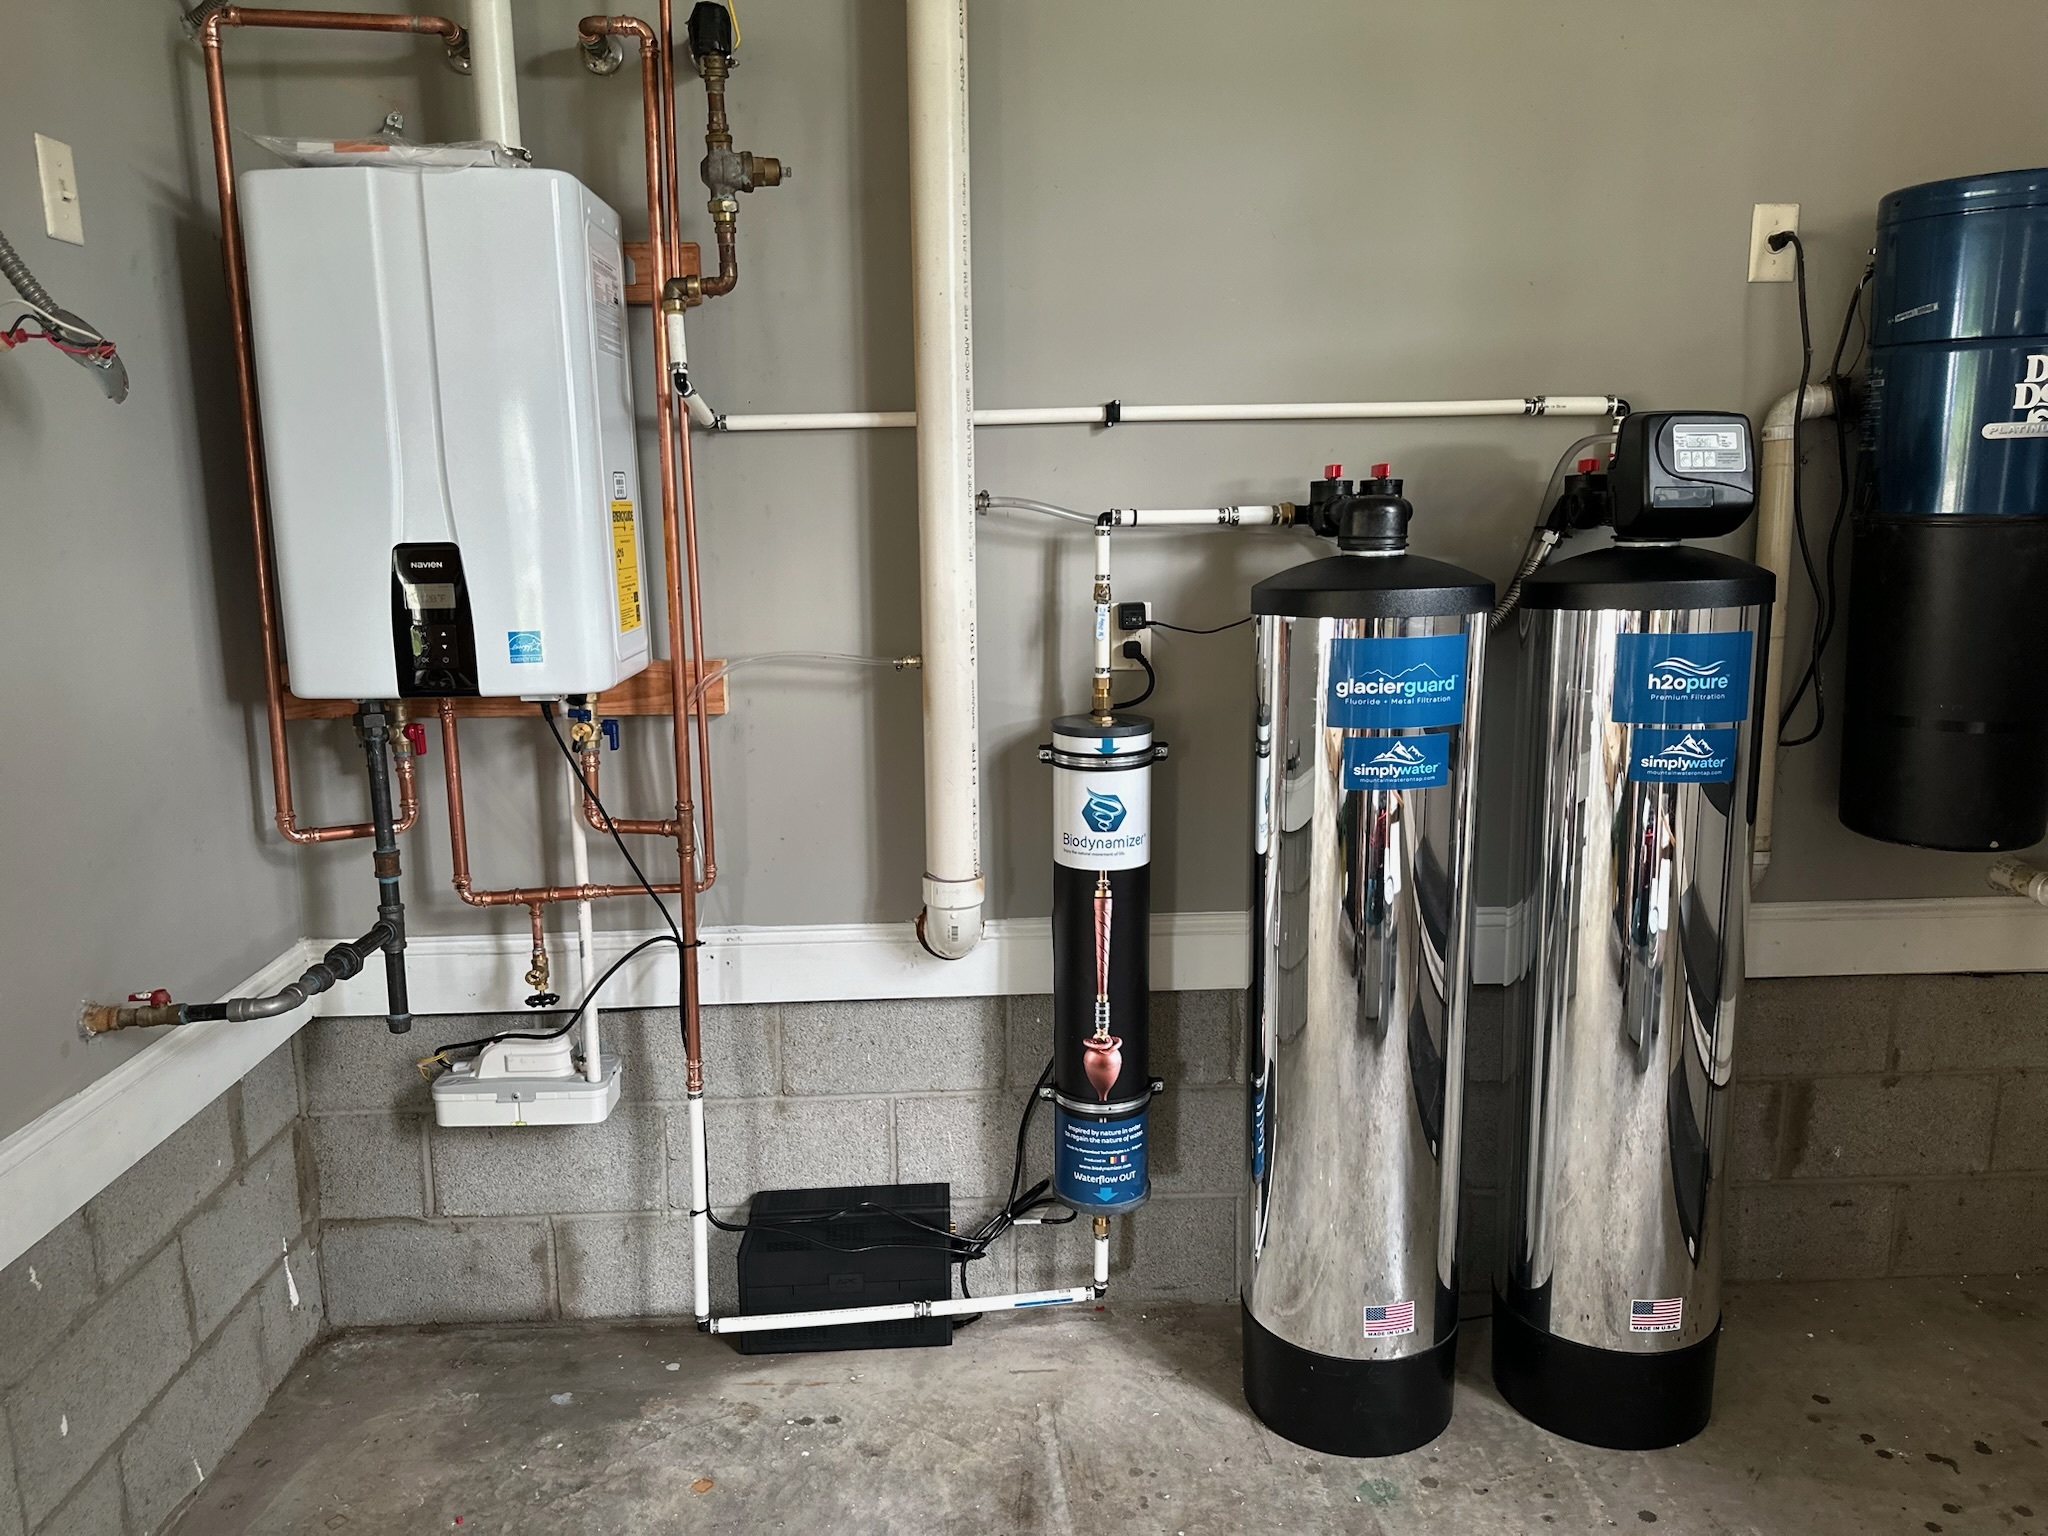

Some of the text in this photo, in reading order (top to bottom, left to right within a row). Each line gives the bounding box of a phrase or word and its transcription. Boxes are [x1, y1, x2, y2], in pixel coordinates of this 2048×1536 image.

[1335, 674, 1455, 698] glacierguard
[1648, 673, 1729, 693] h2opure
[1344, 697, 1381, 705] Fluoride
[1391, 697, 1415, 705] Metal
[1416, 696, 1451, 704] Filtration
[1650, 693, 1688, 701] Premium
[1641, 755, 1726, 771] simplywater
[1353, 763, 1439, 779] simplywater
[1068, 1124, 1090, 1135] Inspired
[1091, 1129, 1099, 1137] by
[1128, 1123, 1141, 1132] order
[1071, 1133, 1089, 1142] regain
[1122, 1134, 1130, 1142] of
[1079, 1163, 1132, 1171] www.biodynamizer.com
[1073, 1170, 1136, 1185] Waterflow OUT
